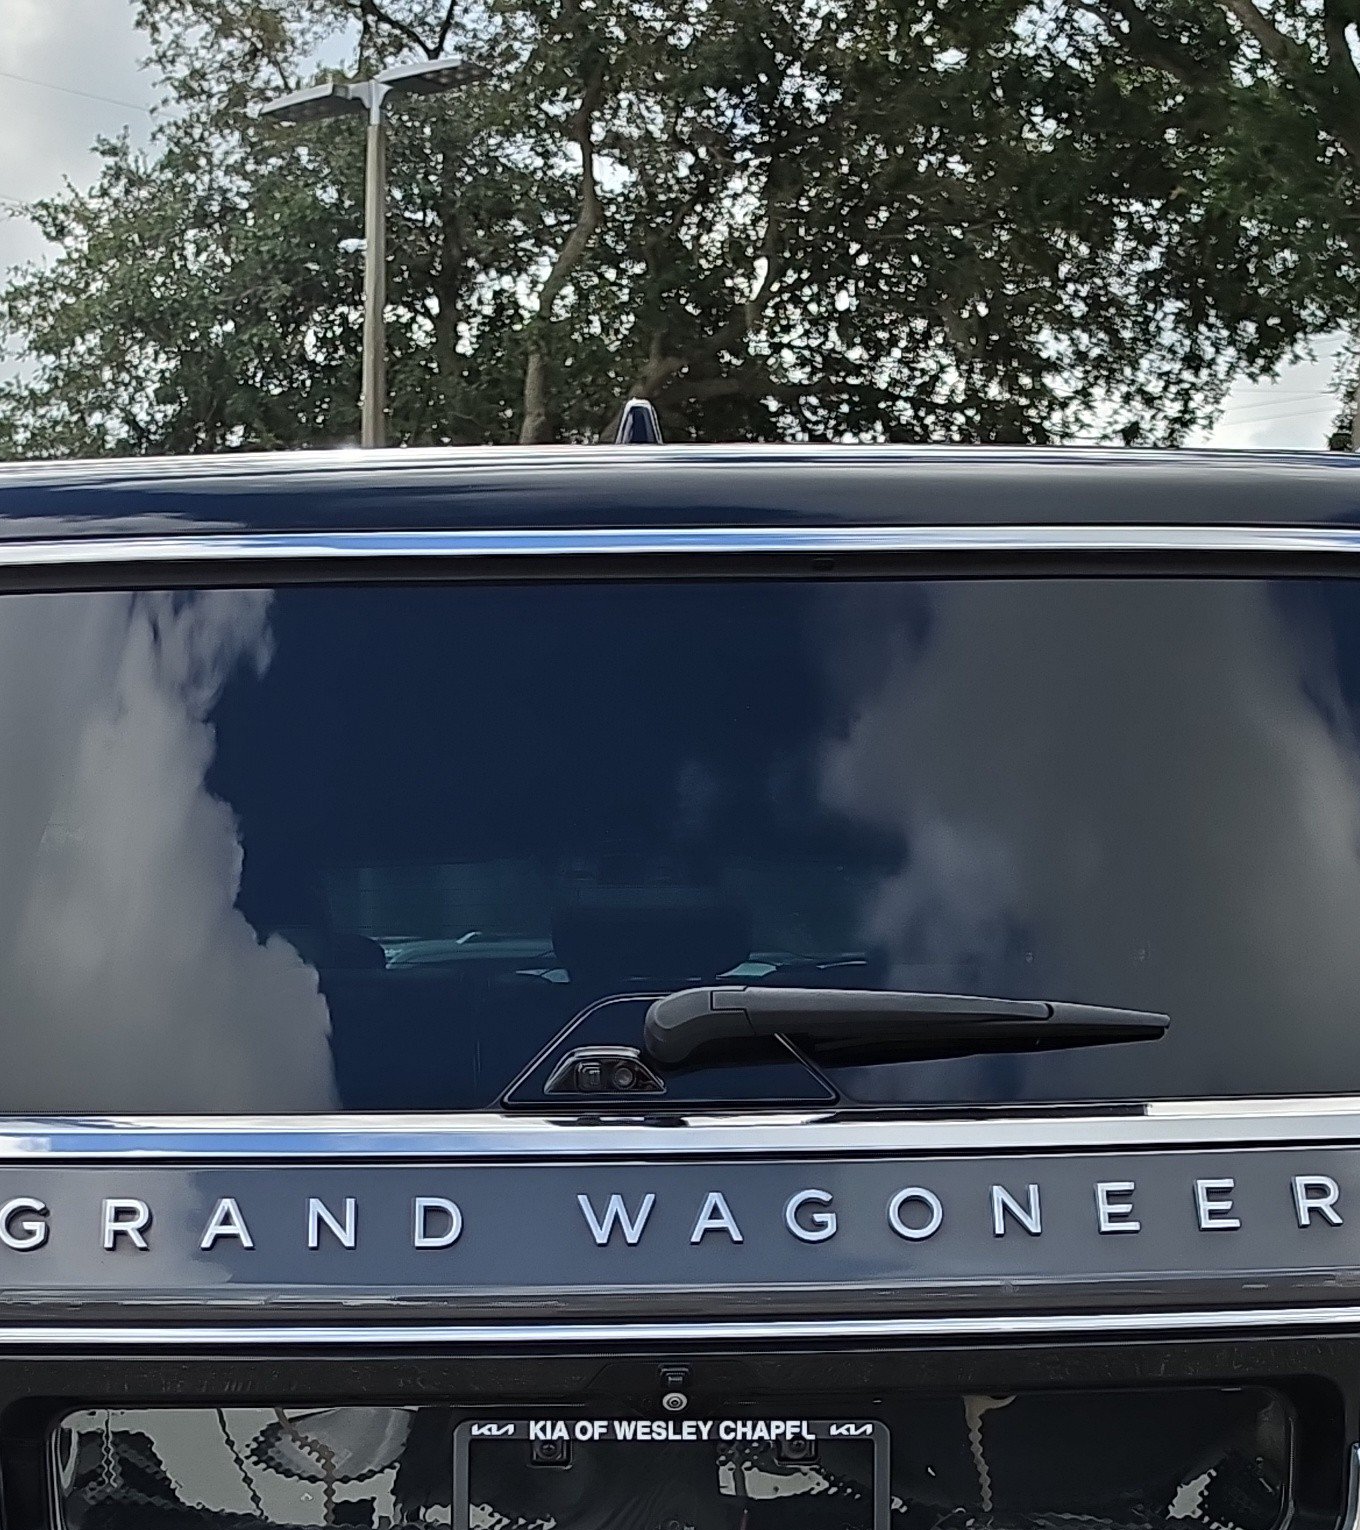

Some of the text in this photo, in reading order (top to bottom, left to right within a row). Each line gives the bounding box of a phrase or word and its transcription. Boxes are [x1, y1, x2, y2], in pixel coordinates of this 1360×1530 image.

[576, 1174, 1344, 1247] WAGONEER
[529, 1420, 569, 1441] KIA
[575, 1420, 609, 1441] OF
[613, 1420, 714, 1441] WESLEY
[718, 1420, 816, 1441] CHAPEL
